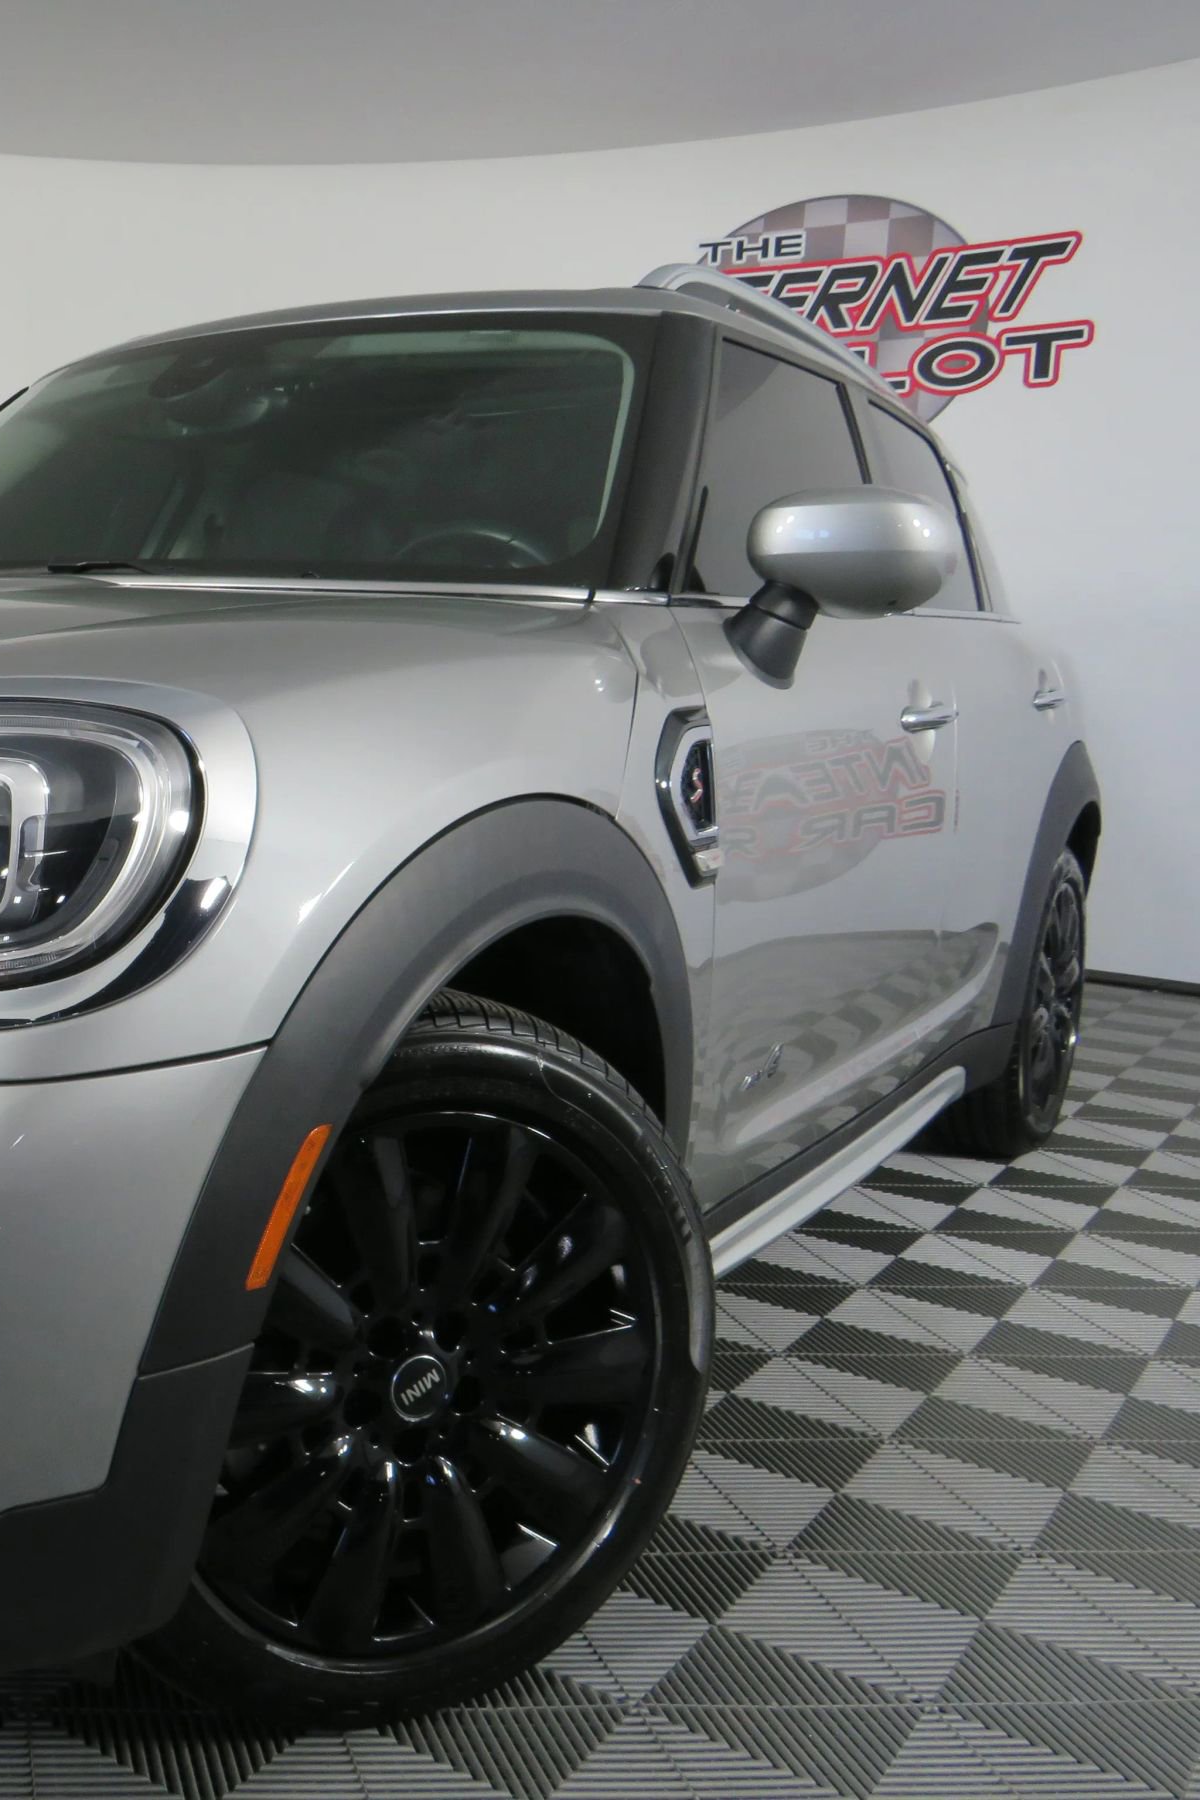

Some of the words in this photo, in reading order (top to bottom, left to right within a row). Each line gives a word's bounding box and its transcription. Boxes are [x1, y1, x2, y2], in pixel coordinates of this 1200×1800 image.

[699, 233, 804, 263] THE
[730, 234, 1080, 333] ERNET
[400, 1368, 441, 1406] MINI
